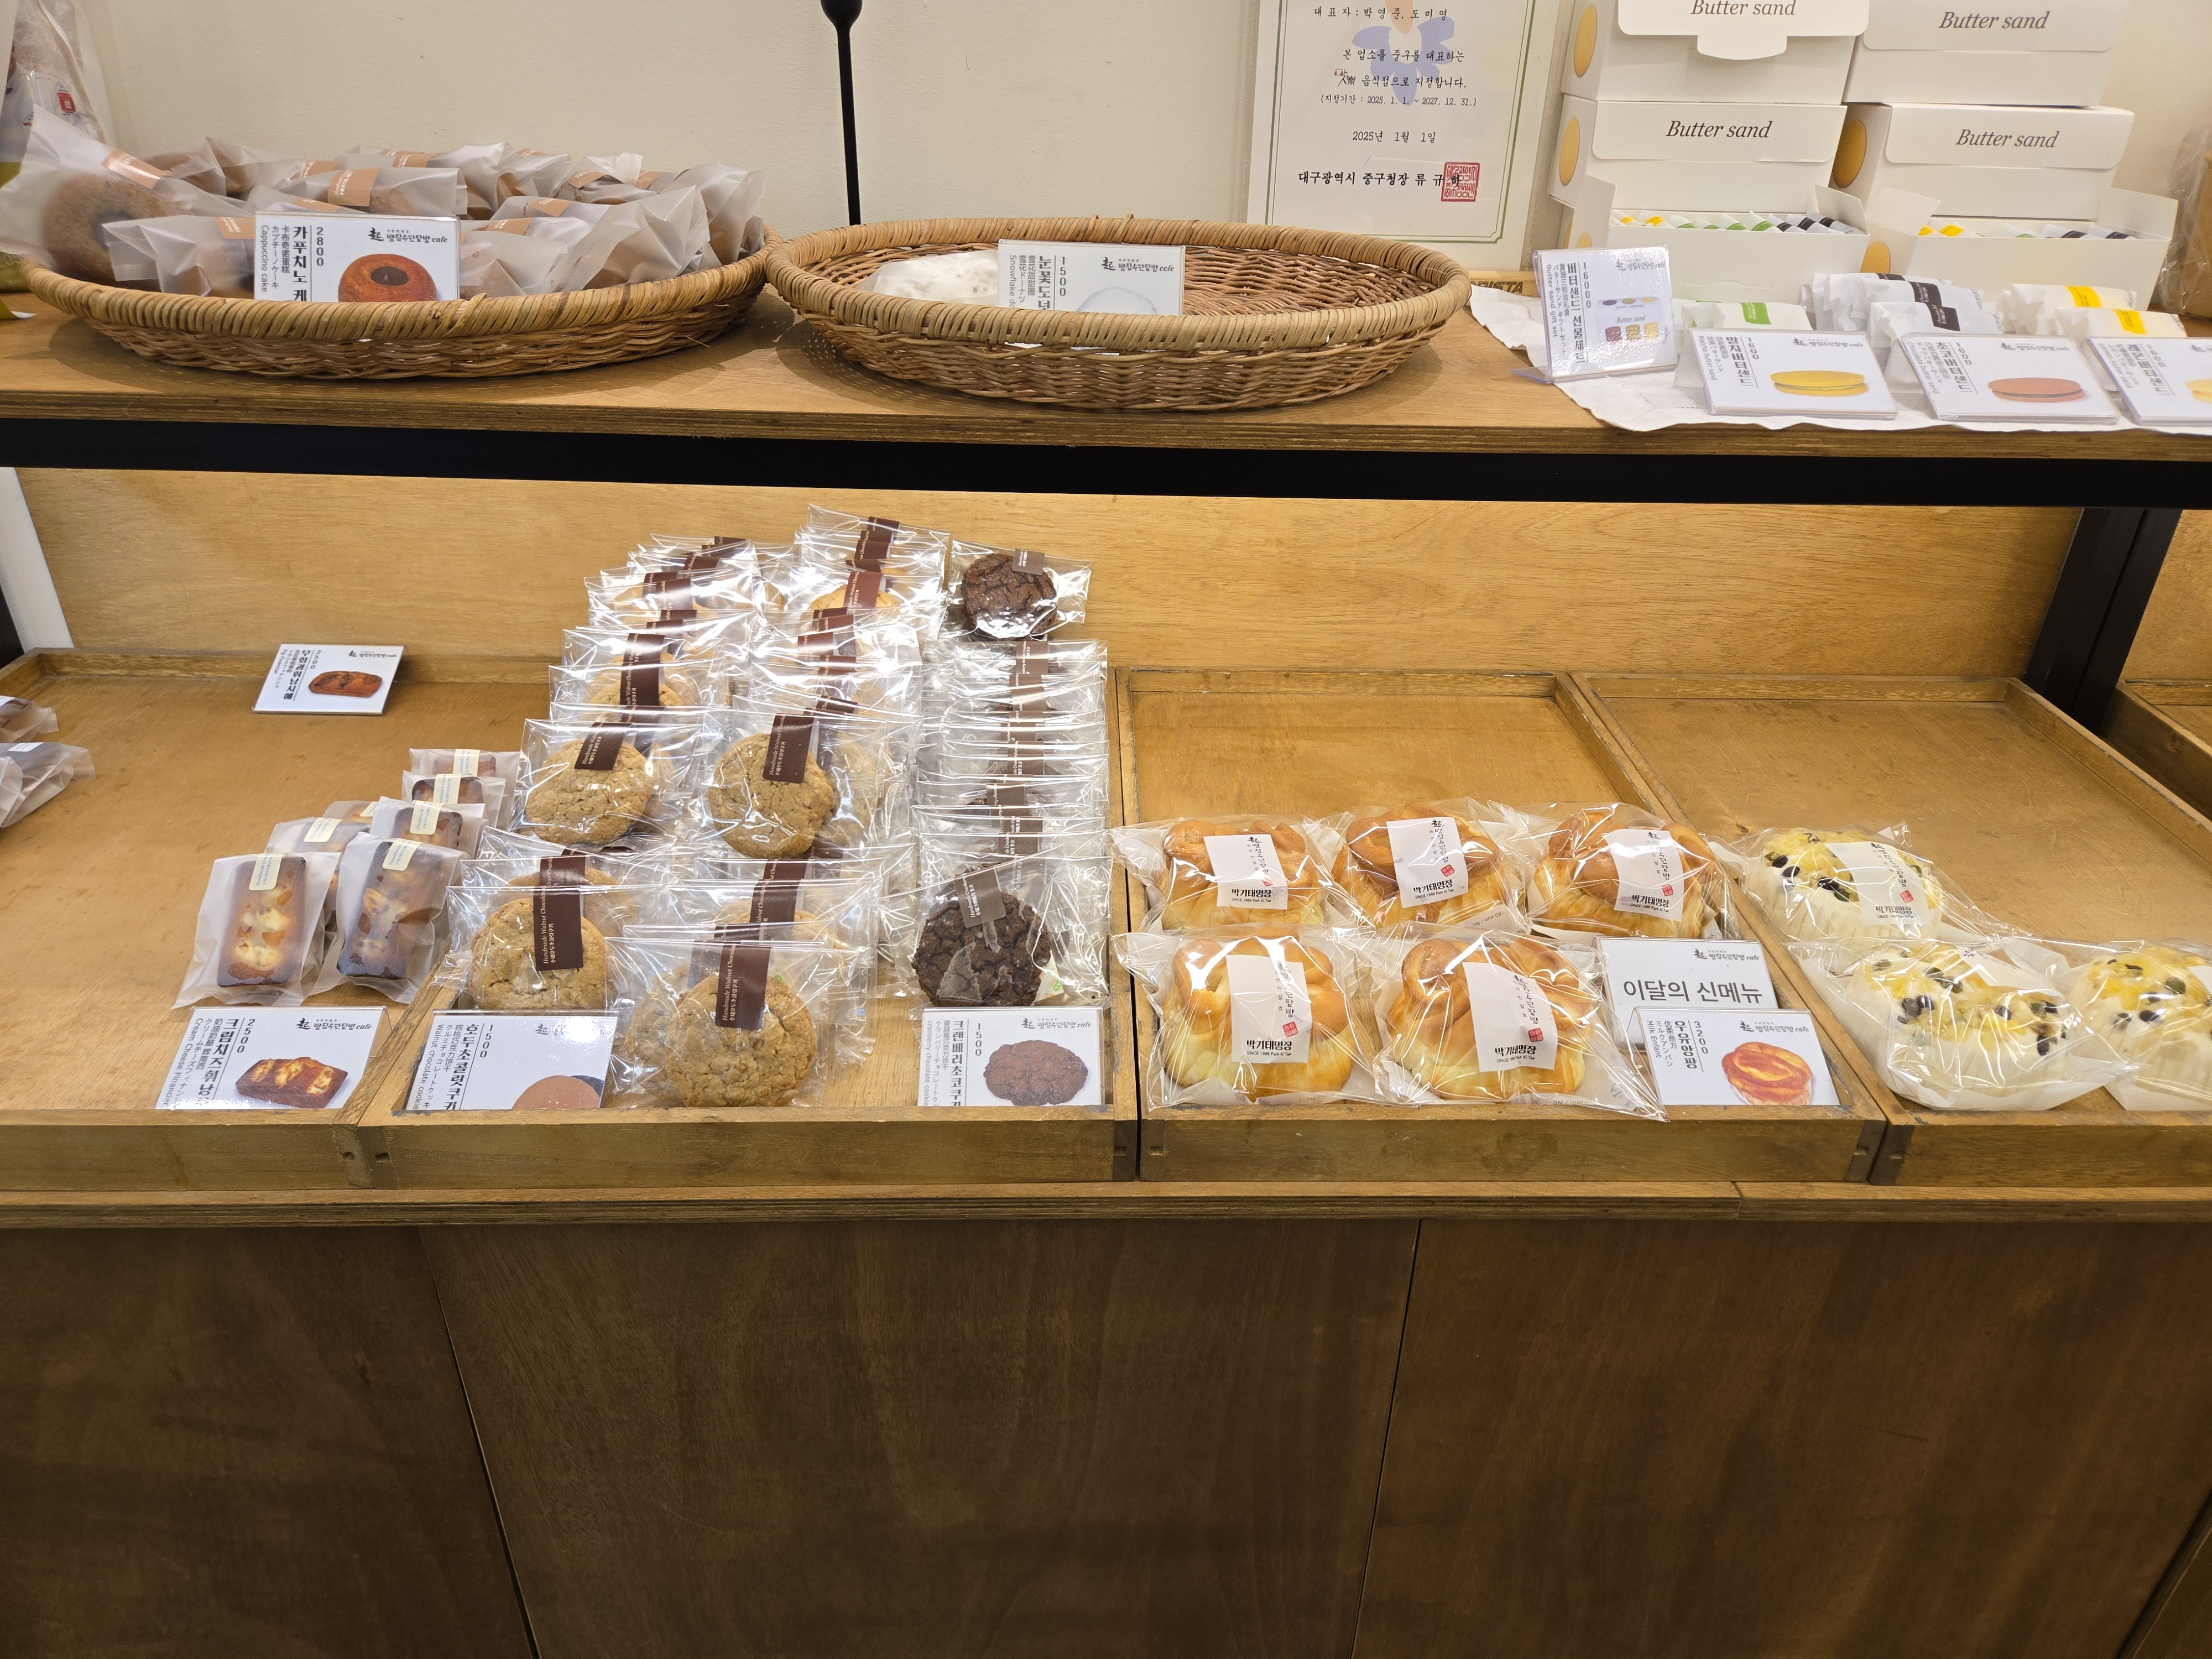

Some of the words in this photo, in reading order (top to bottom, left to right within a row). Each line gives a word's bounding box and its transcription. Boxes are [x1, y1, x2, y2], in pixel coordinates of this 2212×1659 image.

[1691, 0, 1748, 15] Butter
[1752, 0, 1796, 15] sand
[1939, 12, 1999, 30] Butter
[2001, 12, 2049, 30] sand
[1343, 49, 1352, 60] 본
[1358, 49, 1386, 61] 업소를
[1392, 49, 1420, 62] 중구를
[1426, 51, 1464, 62] 대표하는
[1361, 75, 1409, 87] 음식점으로
[1416, 76, 1466, 88] 지정합니다.
[1367, 96, 1386, 105] 2025.
[1422, 97, 1440, 106] 2027.
[1353, 131, 1384, 143] 2025년
[1395, 131, 1410, 143] 1월
[1421, 131, 1436, 144] 1일
[1666, 121, 1723, 139] Butter
[1727, 121, 1772, 139] sand
[1955, 129, 2011, 148] Butter
[2014, 130, 2059, 149] sand
[1298, 171, 1356, 185] 대구광역시
[1362, 173, 1409, 186] 중구청장
[260, 225, 269, 271] Cappuccino
[387, 234, 430, 243] 빵장수단팥빵
[293, 226, 307, 283] 카푸치노
[1027, 255, 1036, 295] 雪花甜甜圈
[1118, 263, 1158, 272] 빵장수단팥빵
[1567, 263, 1580, 310] 버터샌드
[1748, 337, 1759, 359] 1600
[1956, 342, 1973, 365] 1600
[1726, 337, 1754, 386] 말차버터샌드
[1936, 342, 1973, 392] 초코버터샌드
[310, 650, 321, 669] 2500
[283, 650, 311, 700] 무화과휘낭시에
[769, 750, 778, 775] Handmade
[1232, 889, 1272, 898] 박기태명장
[1413, 879, 1453, 894] 박기태명장
[966, 895, 976, 918] Handmade
[1632, 894, 1670, 907] 박기태명장
[1876, 905, 1912, 914] 박기태명장
[1623, 979, 1690, 1002] 이달의
[1696, 981, 1762, 1004] 신메뉴
[722, 990, 731, 1021] Handmade
[189, 1018, 204, 1041] Cream
[205, 1018, 223, 1046] 奶油奶酪
[237, 1019, 255, 1053] 2500
[314, 1022, 356, 1031] 빵장수단팥빵
[431, 1024, 444, 1048] Walnut
[1694, 1021, 1708, 1054] 3200
[1755, 1025, 1794, 1033] 빵장수단팥빵
[443, 1024, 464, 1072] 核桃巧克力饼干
[480, 1025, 493, 1058] 1500
[1246, 1040, 1292, 1050] 박기태명장
[1495, 1045, 1537, 1056] 박기태명장
[1647, 1020, 1655, 1034] Milk
[1651, 1036, 1661, 1058] Enfant
[1657, 1020, 1673, 1067] ミルクアンパン
[1674, 1021, 1697, 1069] 우유앙팡
[176, 1044, 192, 1070] Cheese
[420, 1050, 435, 1084] chocolate
[444, 1024, 479, 1110] 호두초콜릿쿠키
[163, 1072, 181, 1107] Financier
[413, 1086, 424, 1110] cookie
